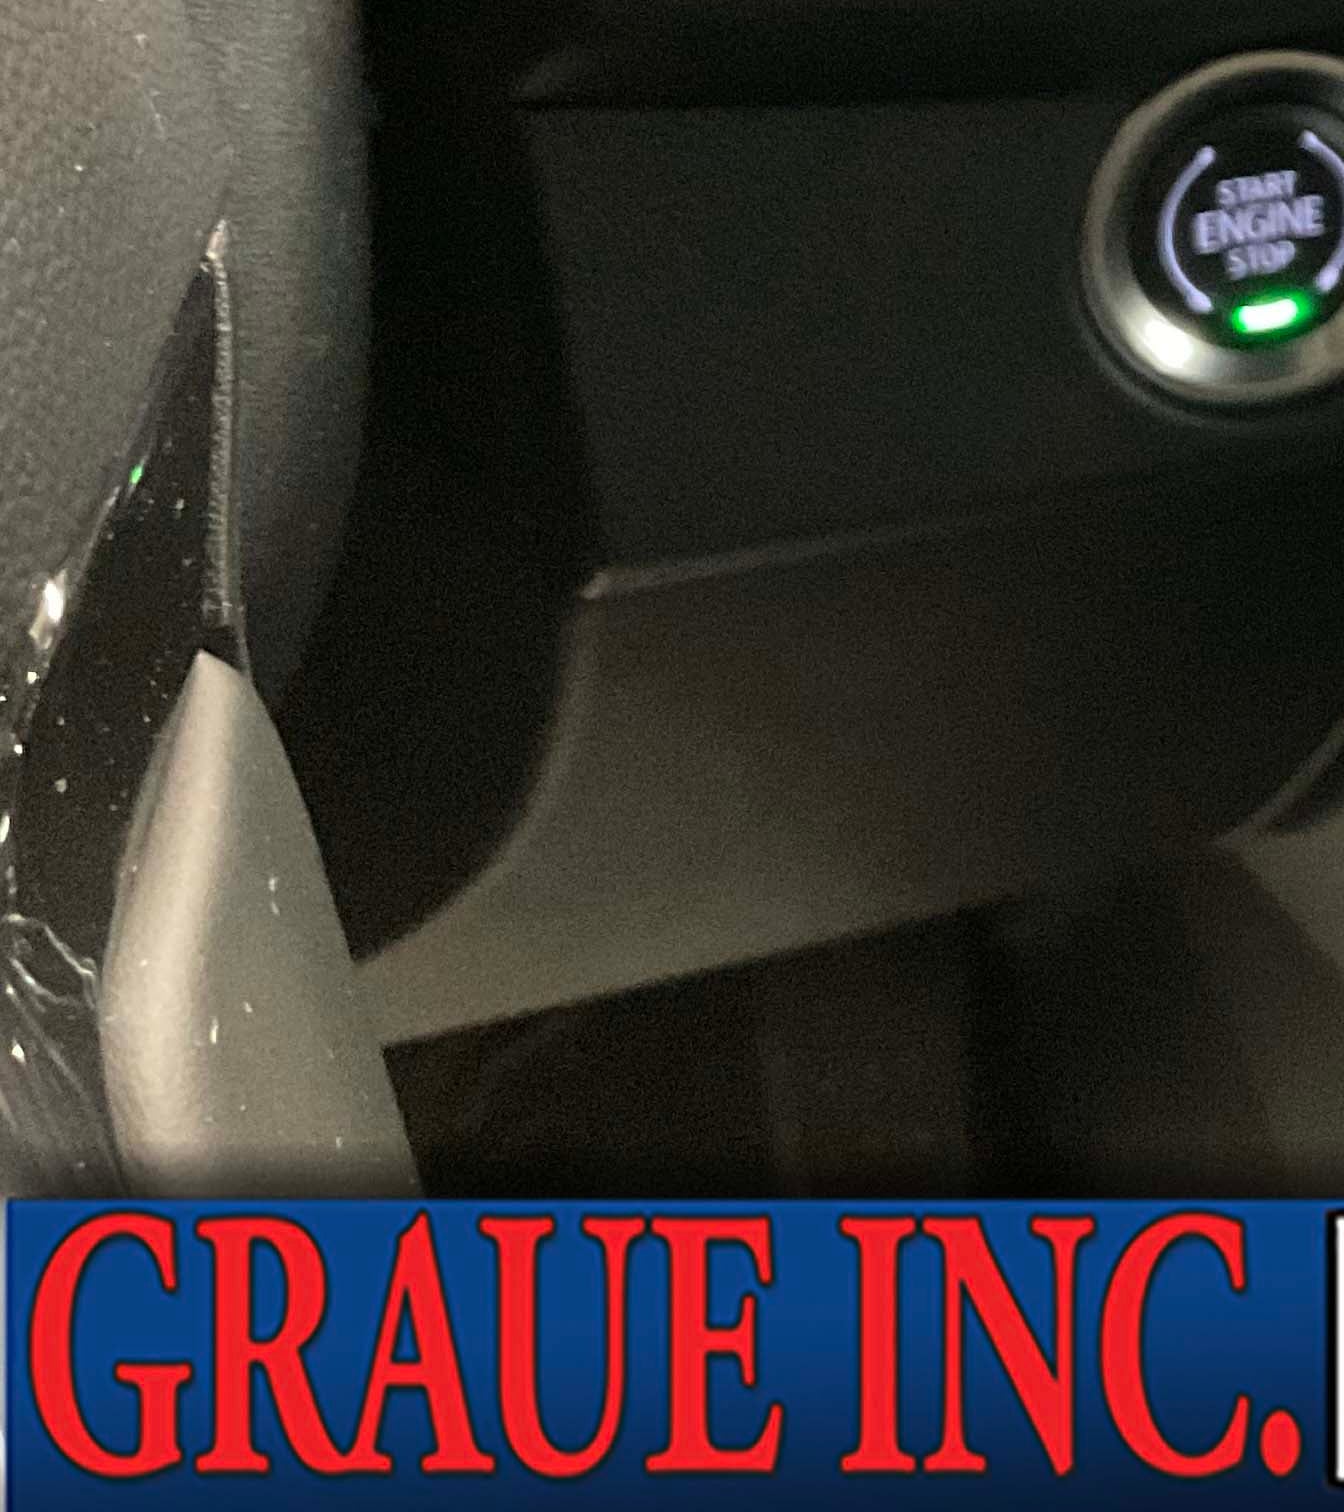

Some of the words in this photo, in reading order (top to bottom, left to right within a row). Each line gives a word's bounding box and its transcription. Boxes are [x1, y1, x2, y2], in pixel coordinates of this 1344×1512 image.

[1214, 170, 1299, 209] START
[1191, 195, 1326, 255] ENGINE
[1225, 240, 1297, 281] STOP
